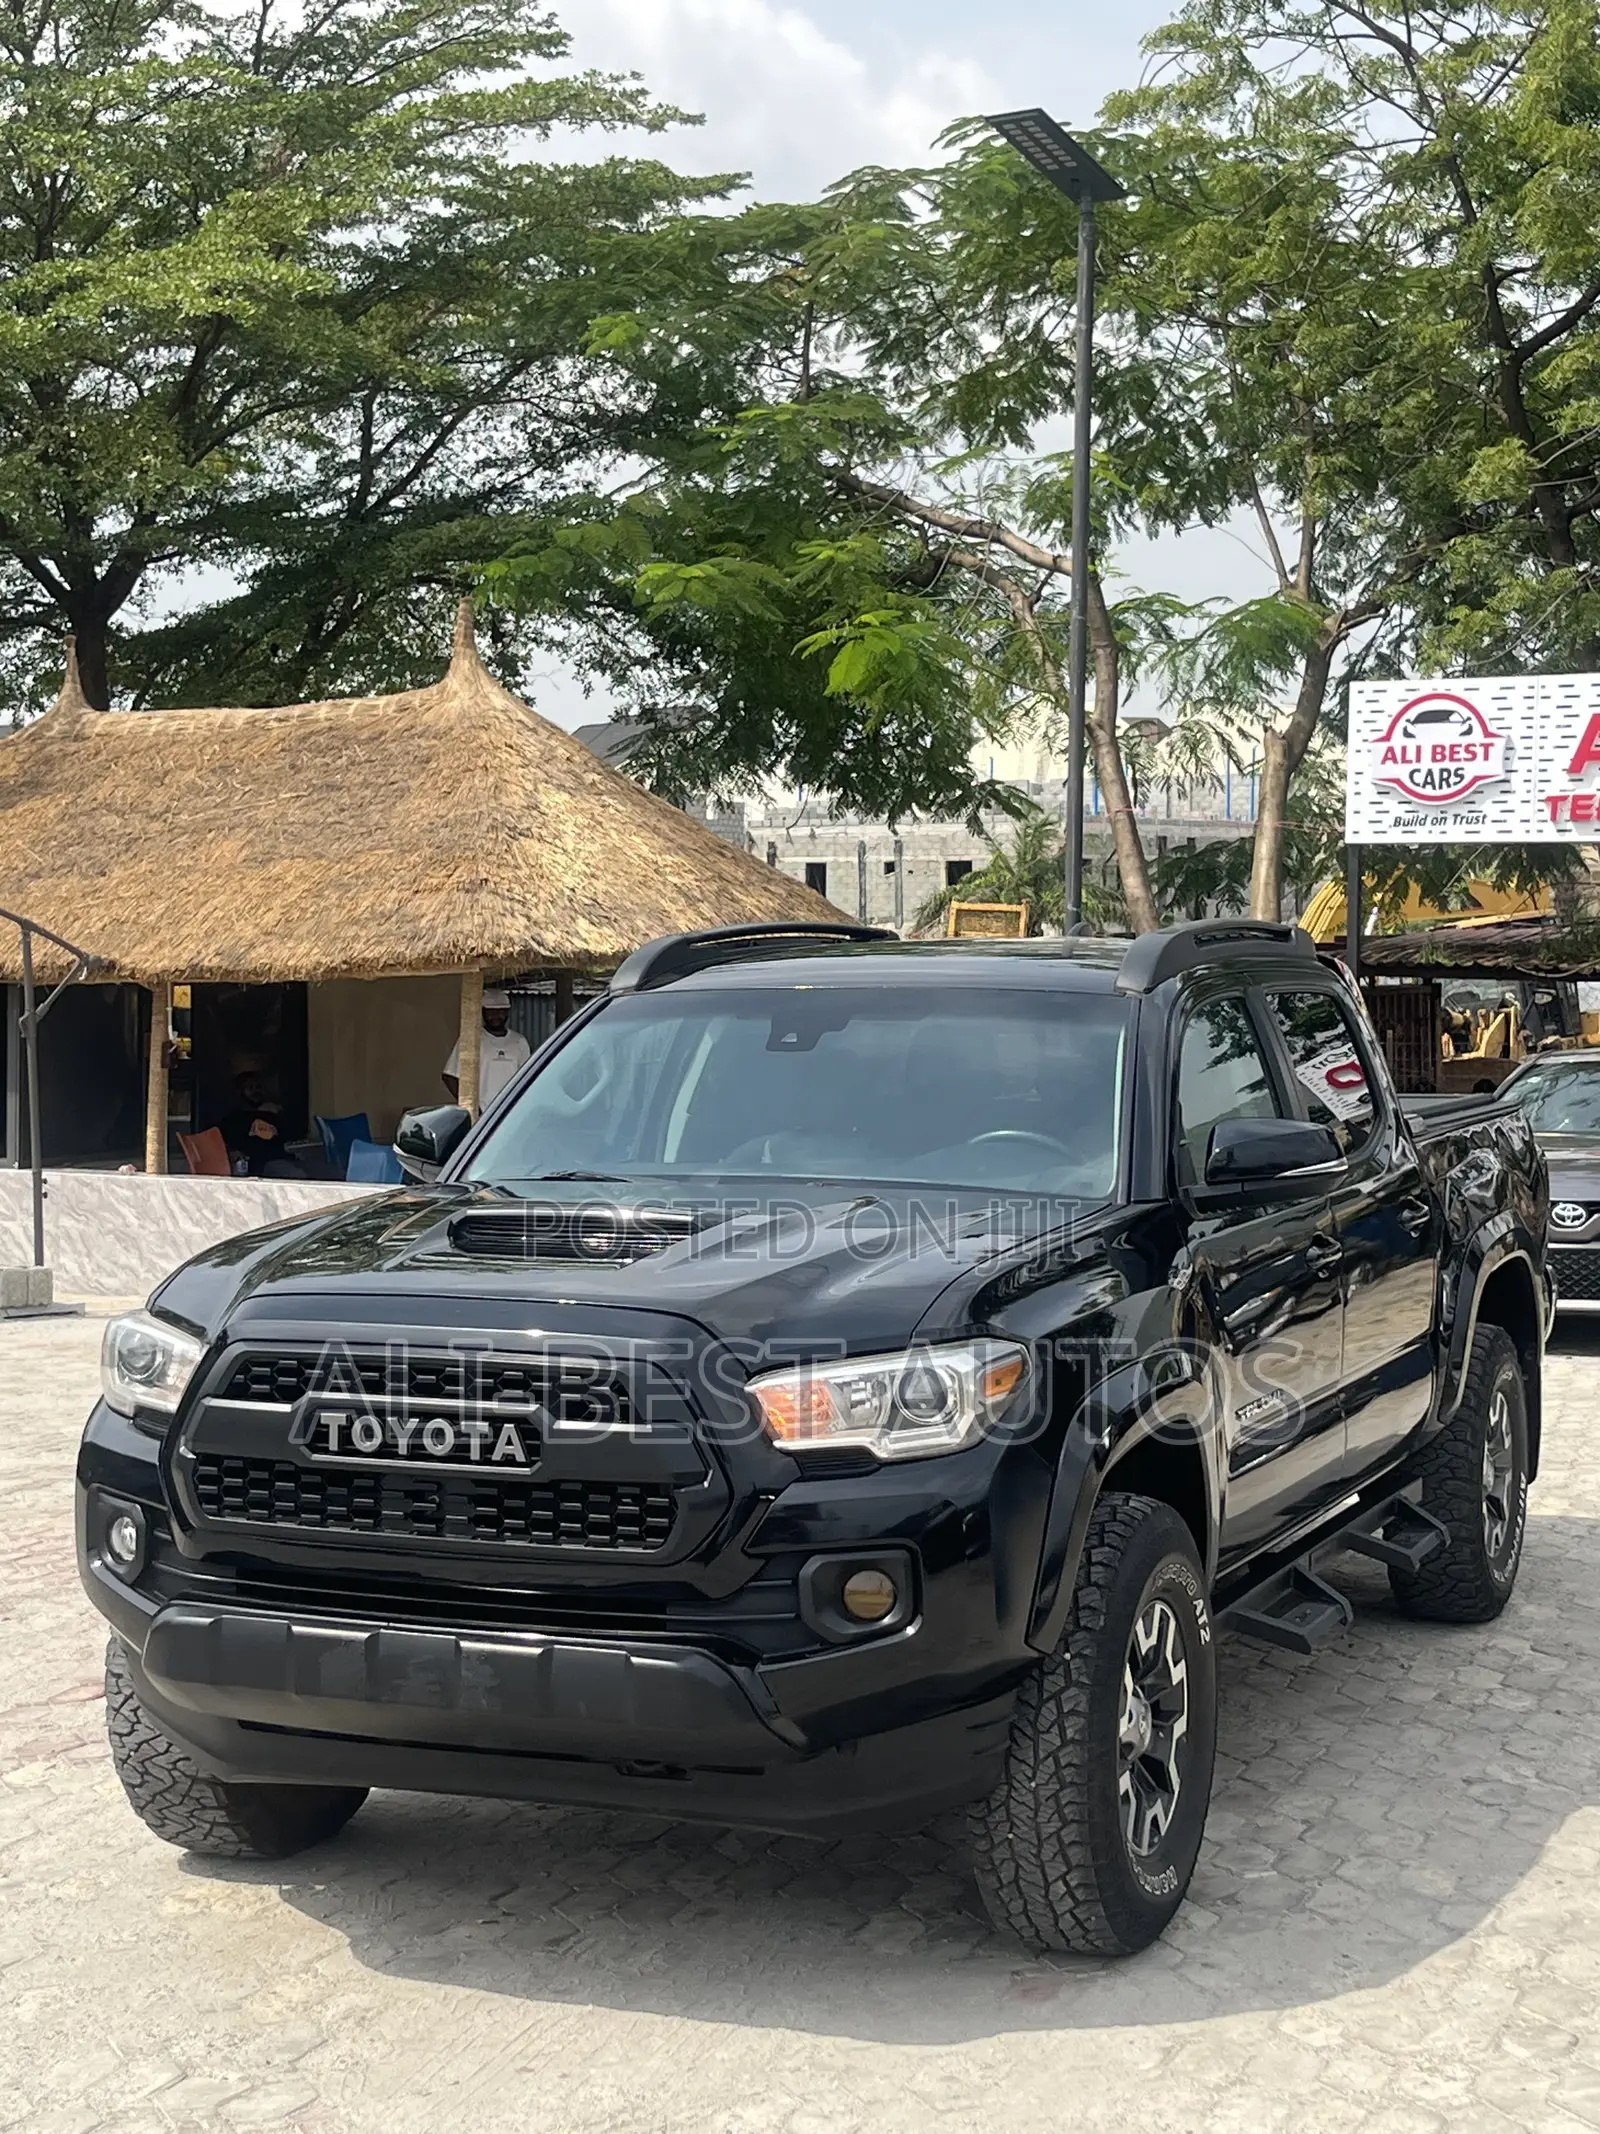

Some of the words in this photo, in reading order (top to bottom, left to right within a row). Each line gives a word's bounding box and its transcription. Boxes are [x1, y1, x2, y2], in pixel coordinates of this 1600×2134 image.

[1381, 745, 1421, 765] ALI
[1431, 743, 1494, 763] BEST
[1409, 767, 1465, 790] CARS
[1544, 794, 1600, 823] TE
[1393, 814, 1428, 828] Build
[1431, 817, 1447, 826] on
[1452, 813, 1488, 825] Trust
[320, 1413, 528, 1462] TOYOTA
